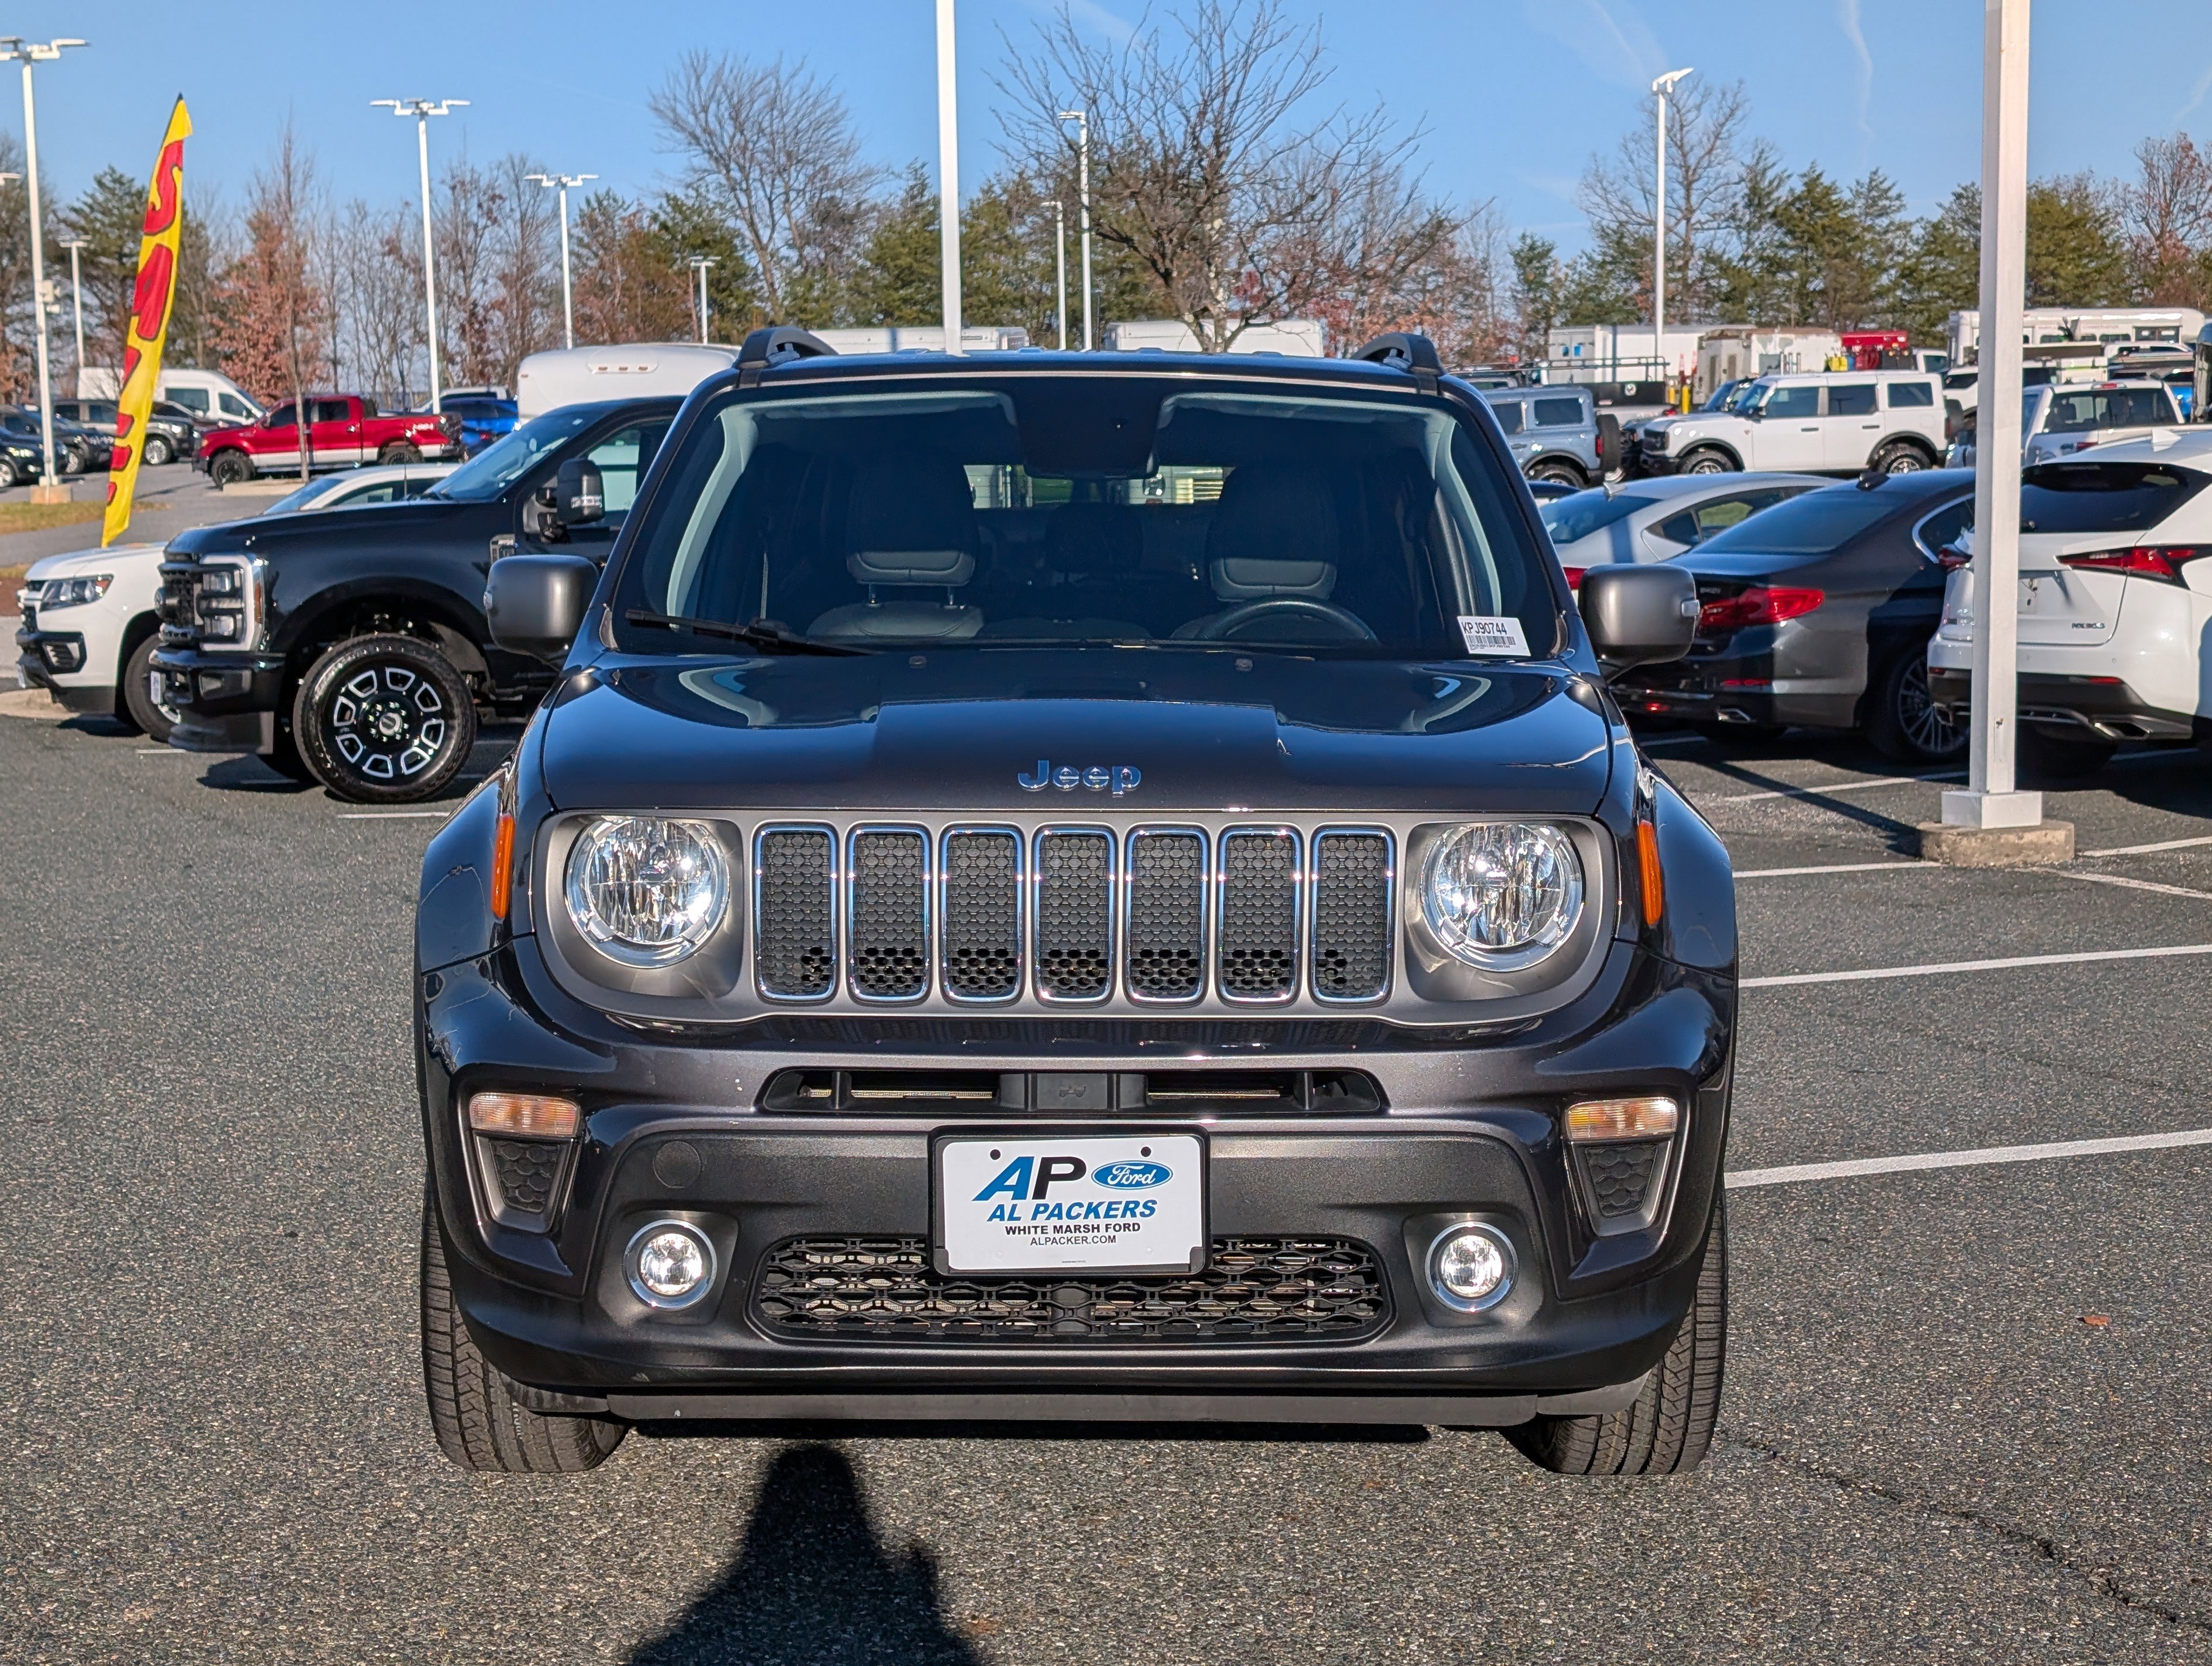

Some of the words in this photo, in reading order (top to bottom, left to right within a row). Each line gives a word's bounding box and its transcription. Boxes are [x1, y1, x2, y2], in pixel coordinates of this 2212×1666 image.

[1018, 760, 1141, 798] Jeep
[971, 1156, 1087, 1201] AP
[1107, 1164, 1158, 1186] Ford
[987, 1203, 1022, 1222] AL
[1030, 1199, 1158, 1221] PACKERS
[1005, 1225, 1049, 1235] WHITE
[1053, 1223, 1101, 1234] MARSH
[1105, 1222, 1141, 1233] FORD
[1030, 1234, 1116, 1246] ALPACKER.COM
